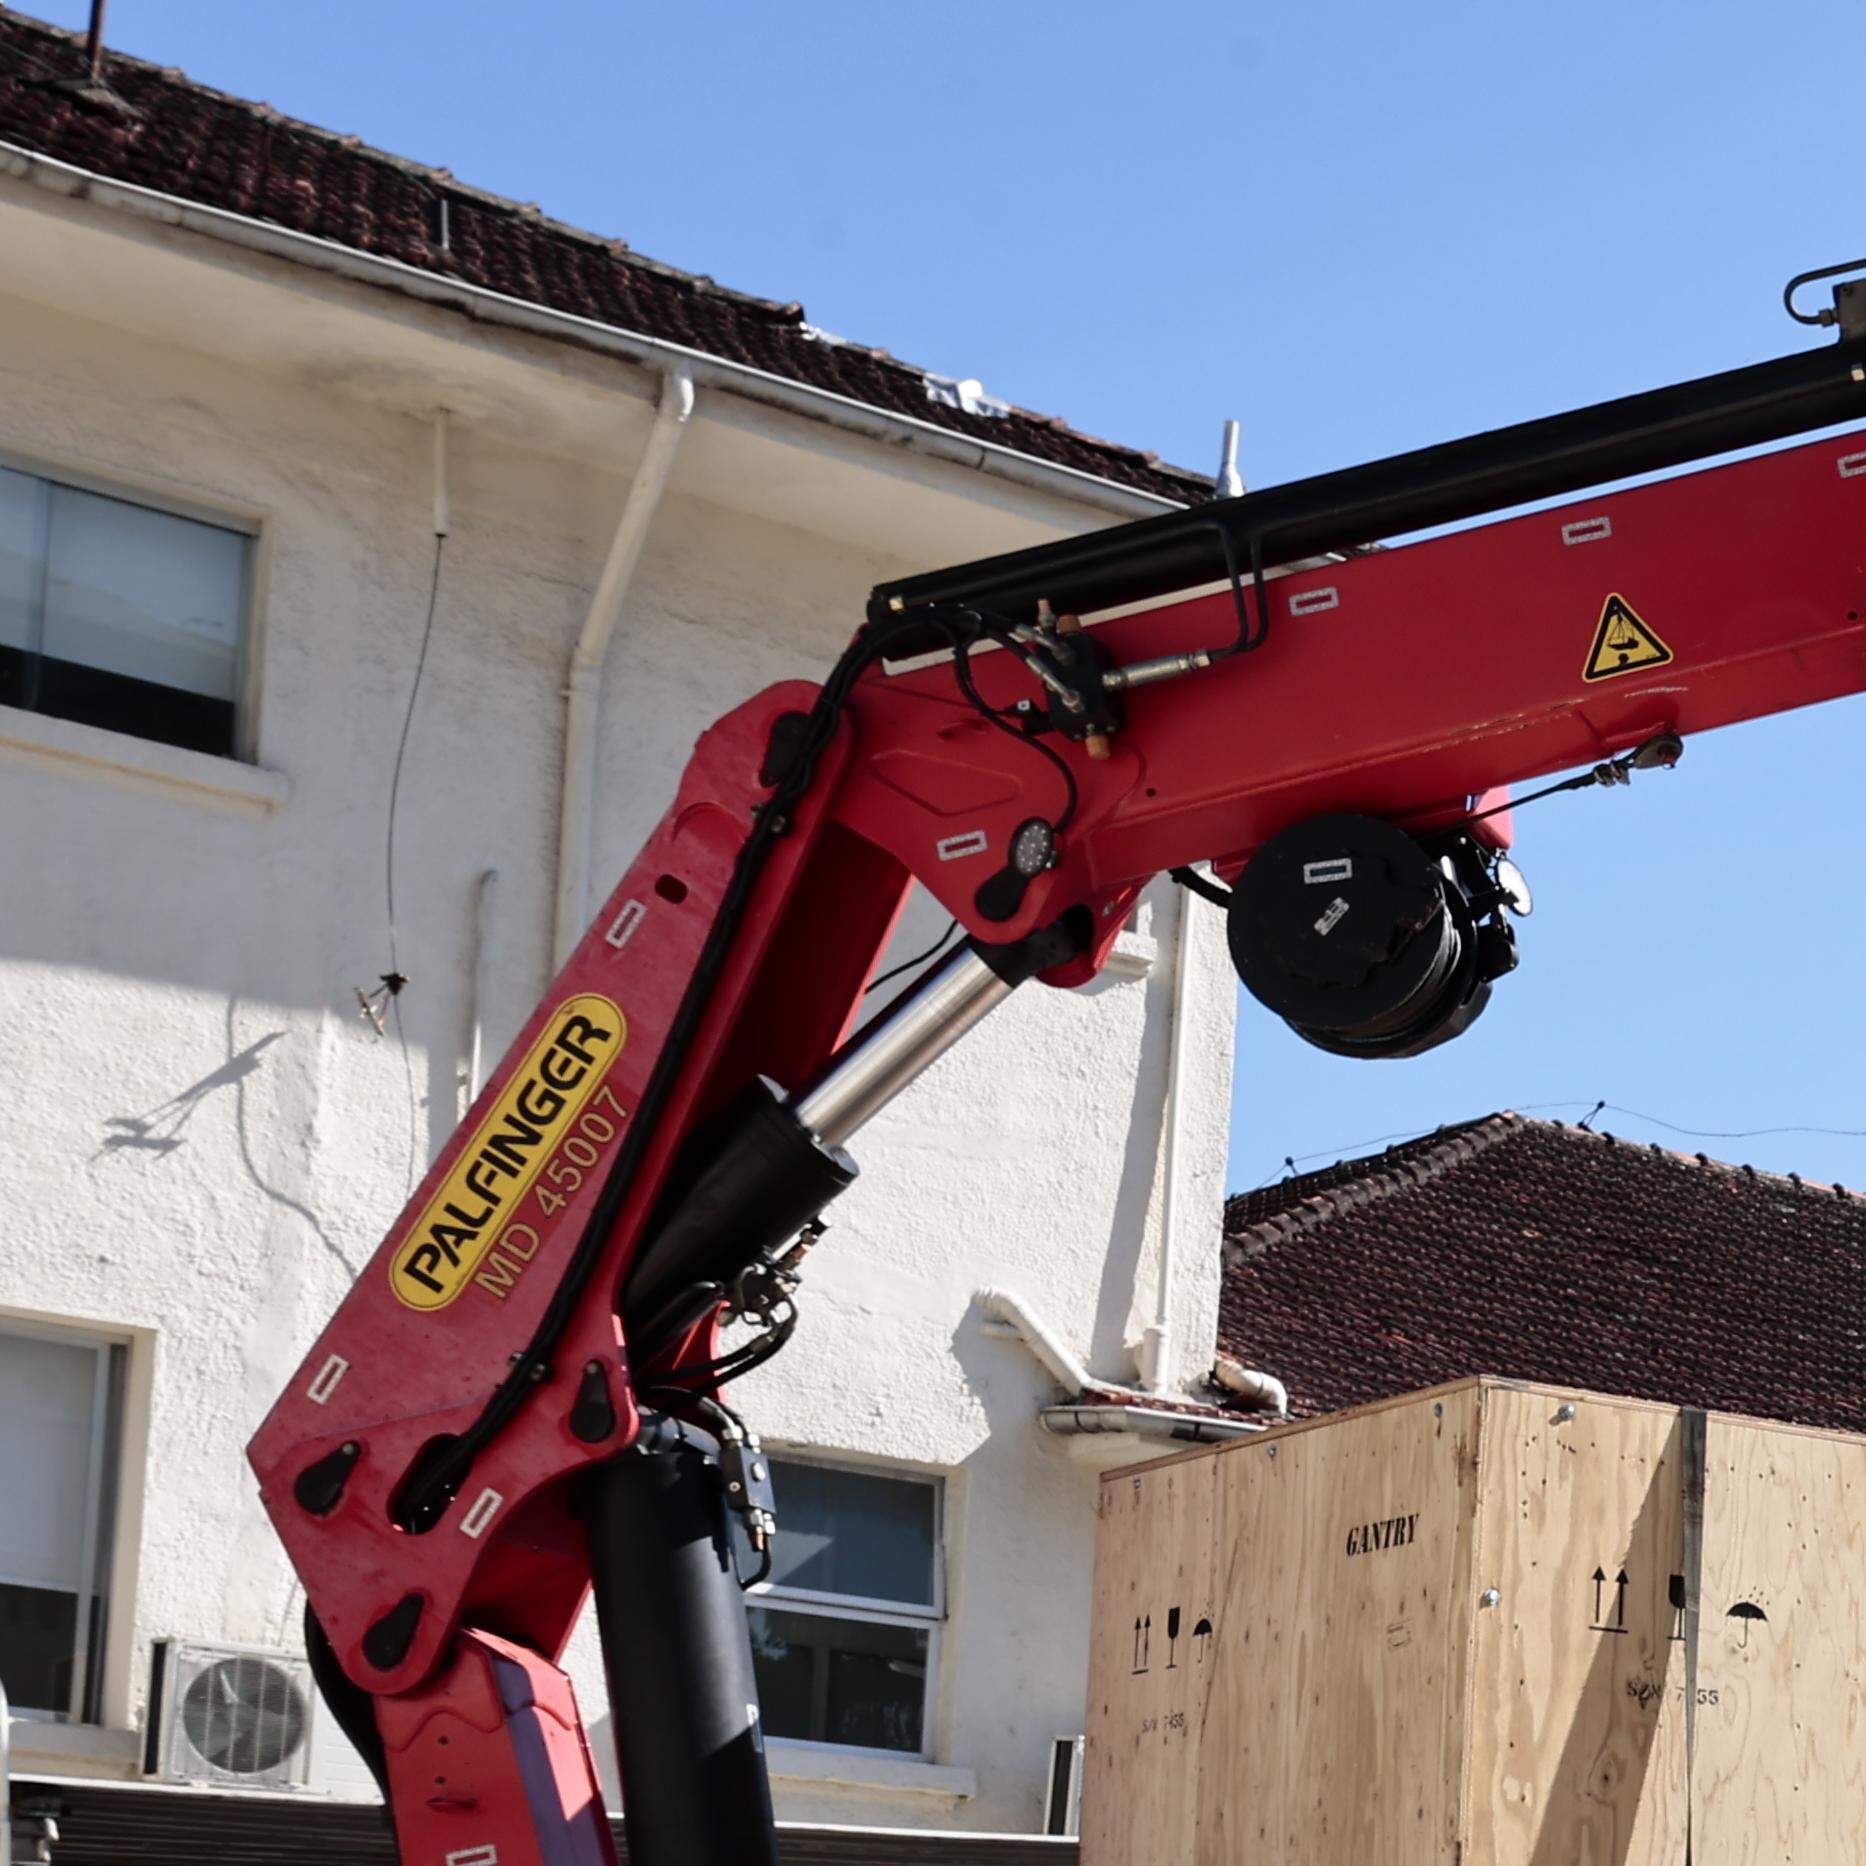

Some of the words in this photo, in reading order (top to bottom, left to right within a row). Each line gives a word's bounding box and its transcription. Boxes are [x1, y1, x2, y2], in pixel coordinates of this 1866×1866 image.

[403, 1014, 611, 1293] PALFINGER
[475, 1223, 541, 1298] MD
[534, 1086, 627, 1216] 45007
[1346, 1514, 1420, 1557] GANTRY
